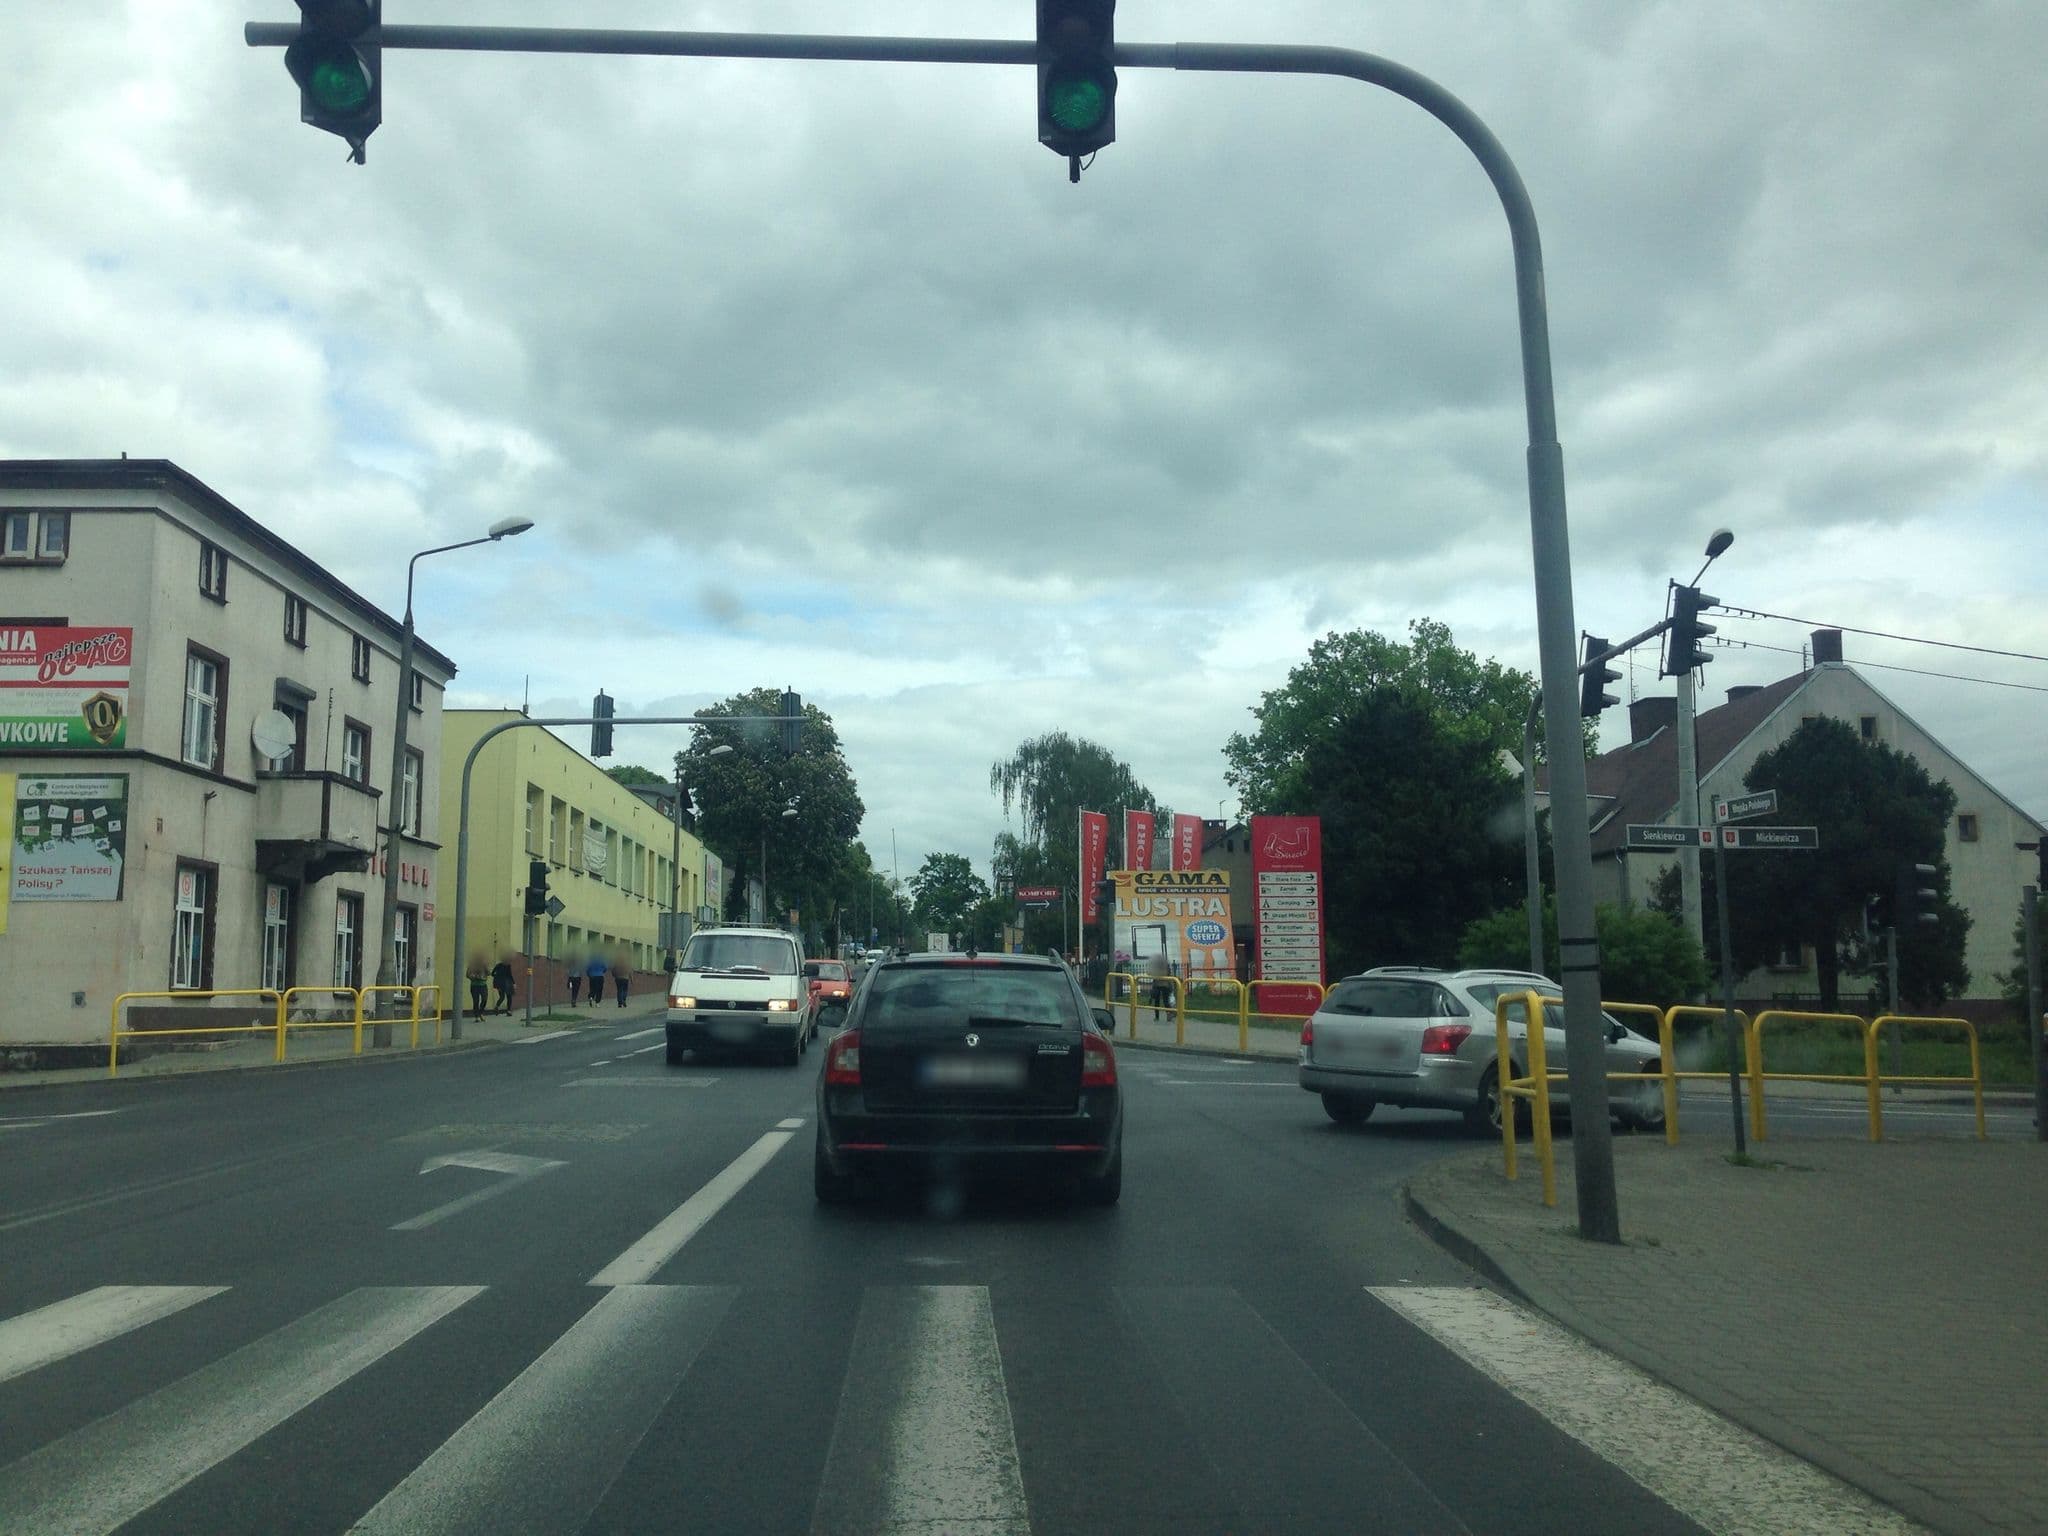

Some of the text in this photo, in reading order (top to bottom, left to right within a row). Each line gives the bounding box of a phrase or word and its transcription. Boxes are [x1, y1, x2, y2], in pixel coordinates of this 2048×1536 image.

[44, 632, 118, 662] najlepsze
[38, 636, 127, 684] OC AC
[1642, 831, 1686, 841] Sienkiewicza
[1755, 833, 1800, 843] Mickiewicza
[18, 865, 112, 876] Szukasz Tańszej
[18, 879, 53, 889] Polisy
[1134, 872, 1226, 886] GAMA
[1115, 896, 1226, 917] LUSTRA
[1191, 924, 1220, 934] SUPER
[1191, 932, 1221, 942] OFERTA
